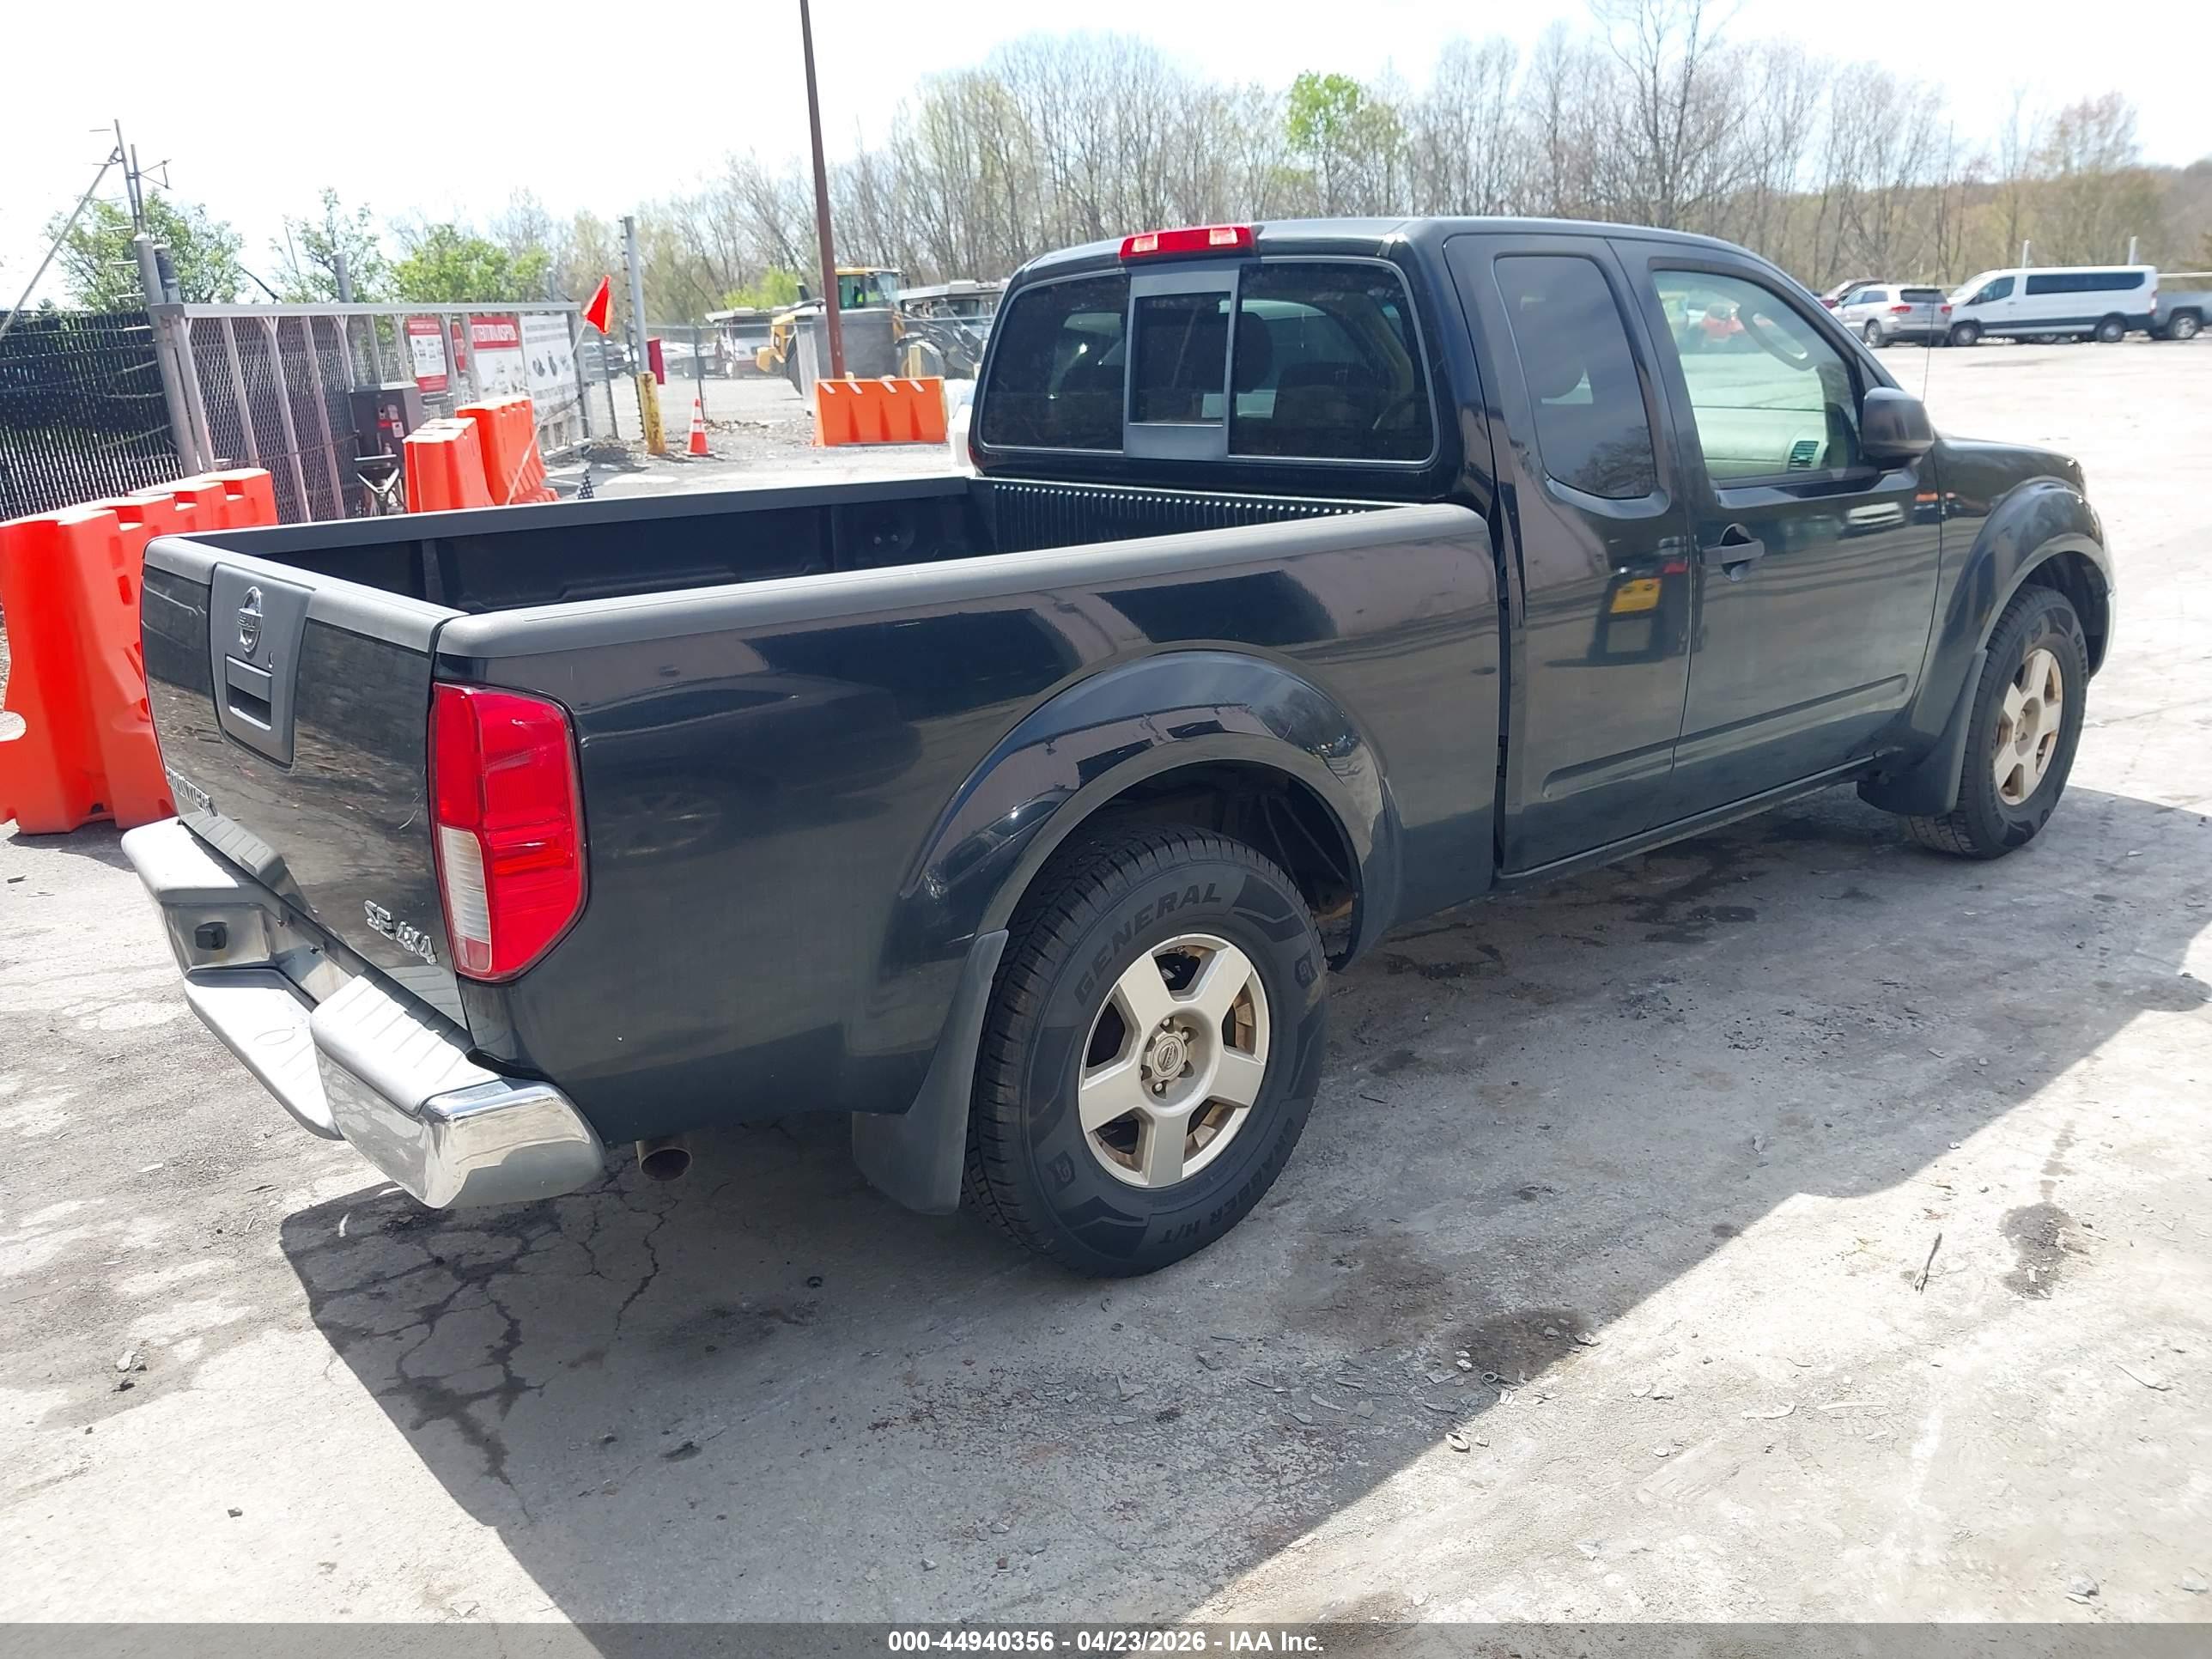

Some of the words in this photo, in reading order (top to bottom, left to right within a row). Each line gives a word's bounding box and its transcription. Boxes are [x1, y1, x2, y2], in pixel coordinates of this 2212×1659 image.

[364, 899, 395, 941] SE
[1073, 882, 1223, 1006] GENERAL
[1158, 1218, 1201, 1245] H/T
